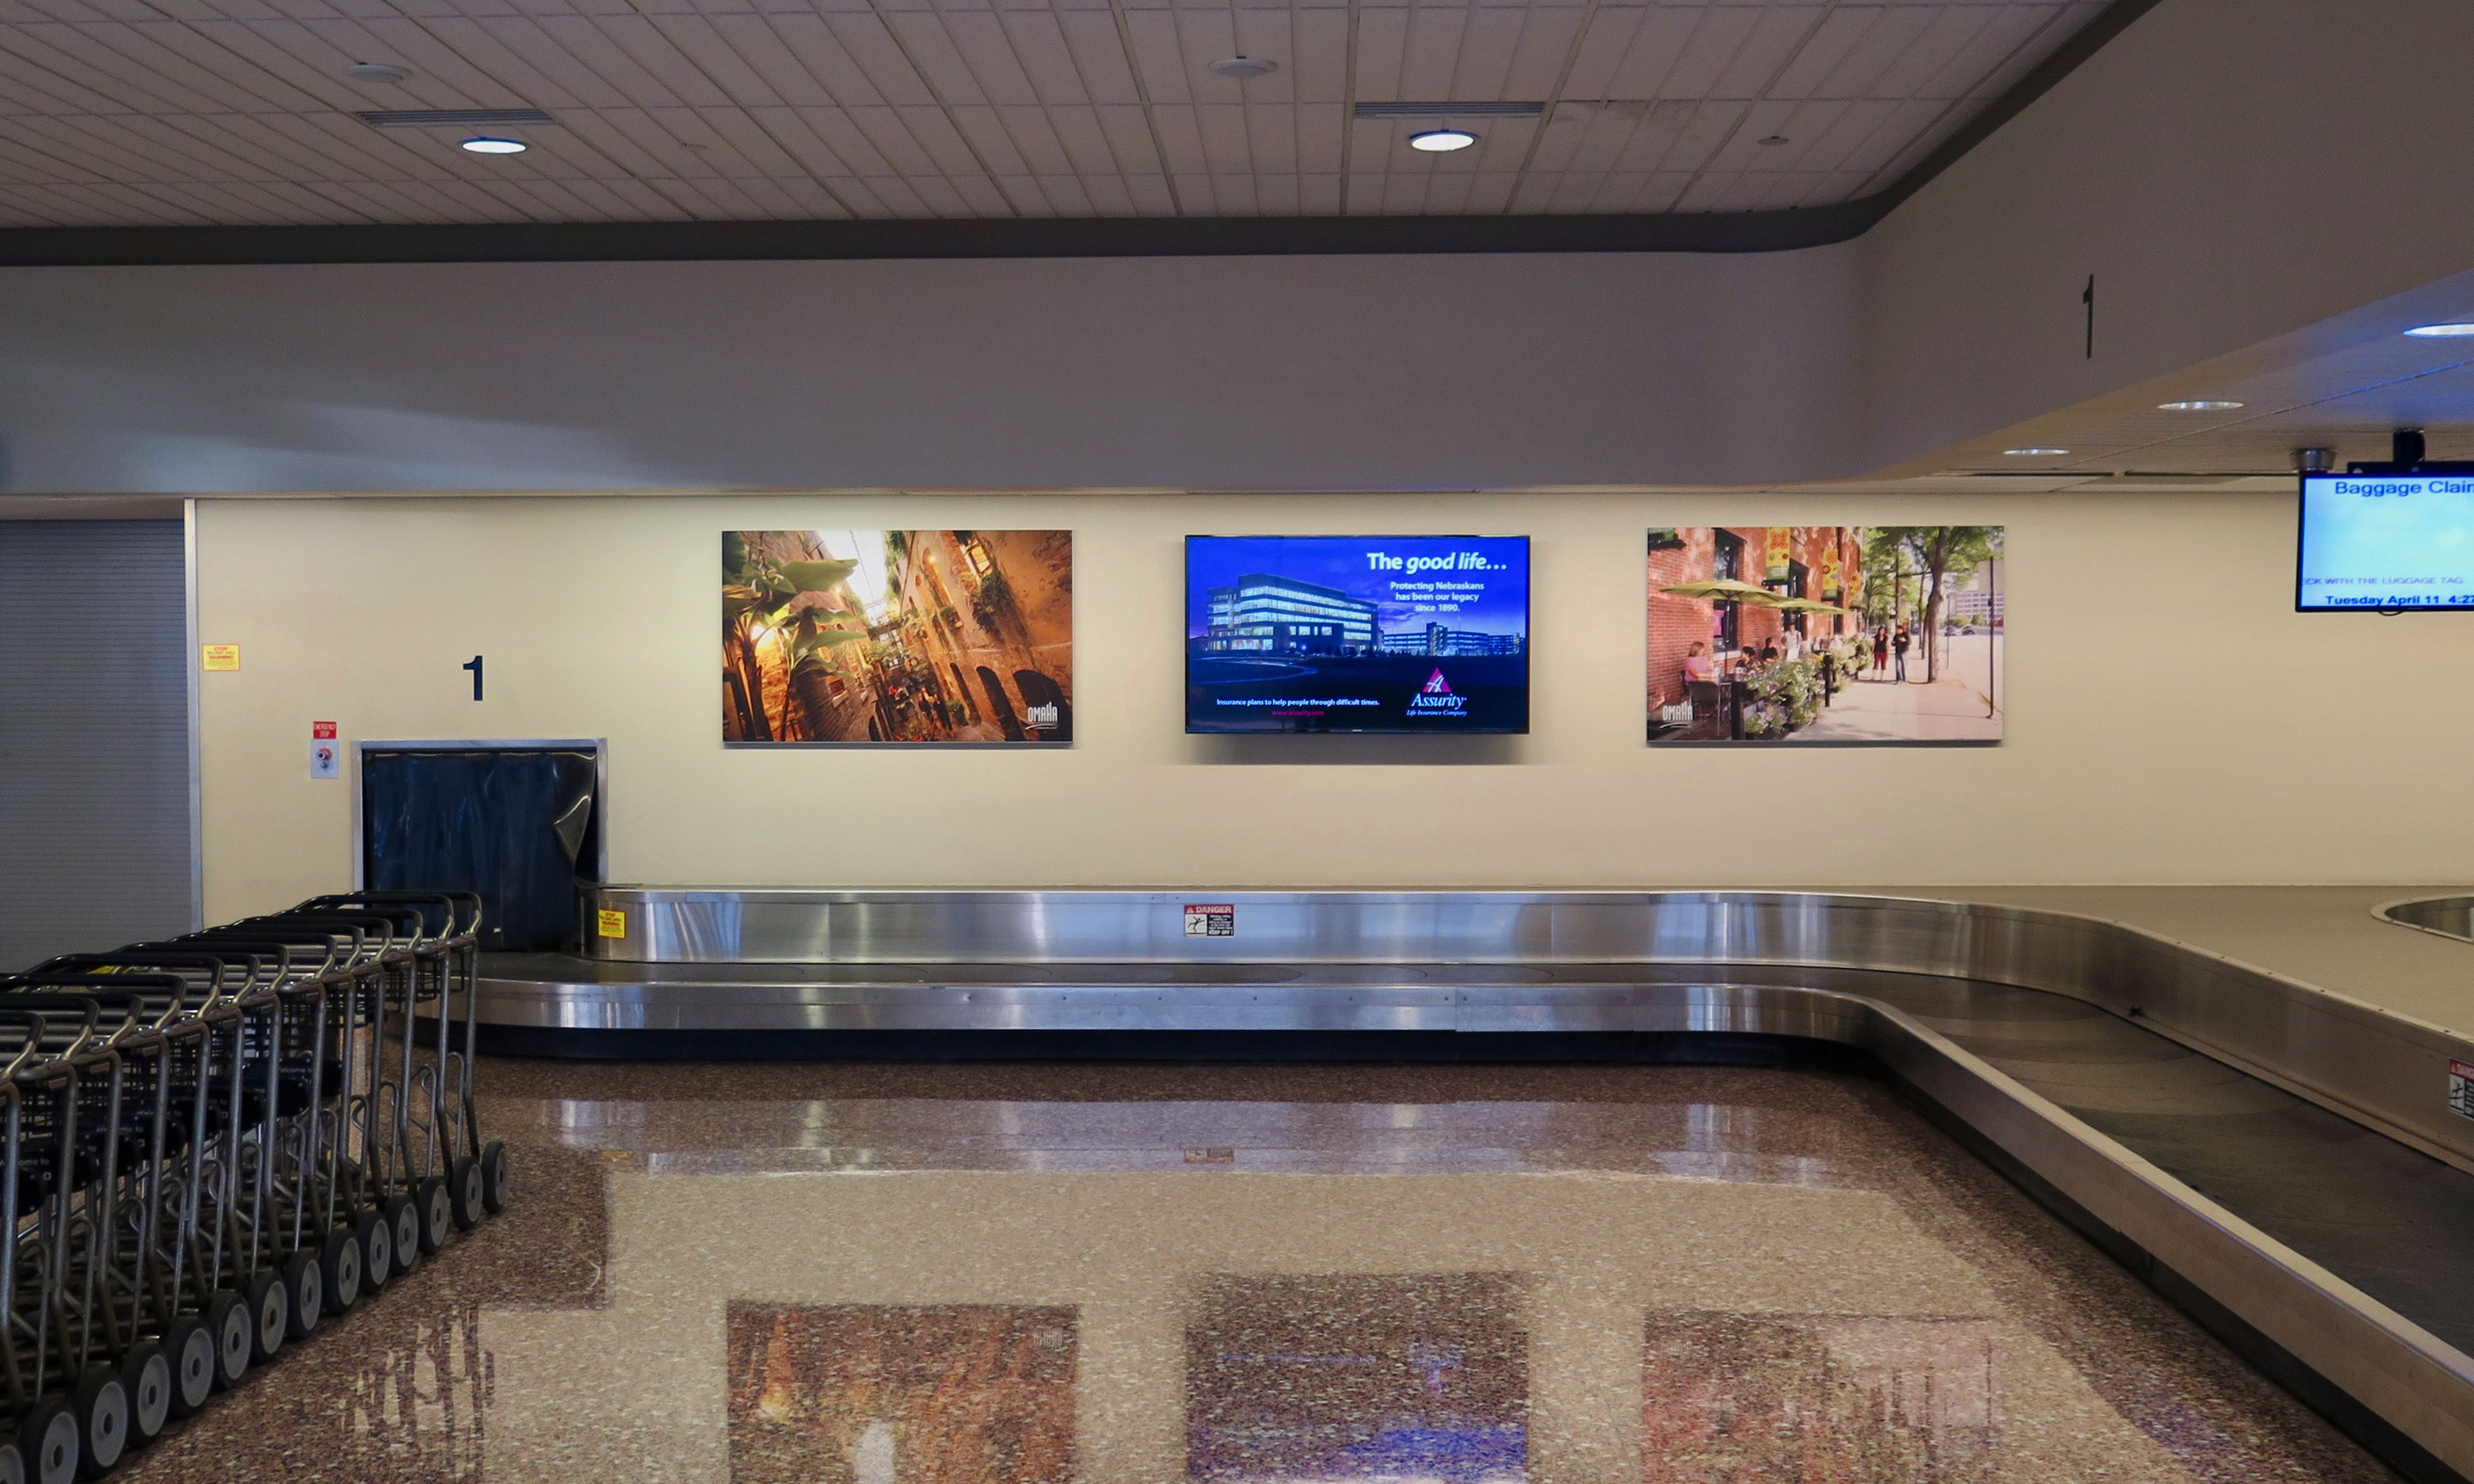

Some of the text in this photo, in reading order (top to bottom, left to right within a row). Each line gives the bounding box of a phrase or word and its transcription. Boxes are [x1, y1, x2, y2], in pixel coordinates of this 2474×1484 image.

[2083, 274, 2094, 359] 1
[2335, 481, 2423, 497] Baggage
[1366, 552, 1507, 574] The good life...
[1390, 581, 1484, 591] Protecting Nebraskans
[1395, 592, 1410, 601] has
[1412, 592, 1433, 601] been
[1452, 592, 1479, 602] legacy
[2326, 595, 2383, 606] Tuesday
[2387, 595, 2420, 605] April
[2425, 595, 2439, 603] 11
[1415, 603, 1460, 612] since 1890.
[463, 655, 482, 701] 1
[1247, 699, 1263, 707] plans
[1272, 699, 1286, 707] help
[1287, 699, 1309, 707] people
[1310, 699, 1335, 707] through
[1411, 693, 1465, 710] Assurity
[1028, 702, 1058, 722] OMAHA
[1663, 701, 1693, 721] OMAHA
